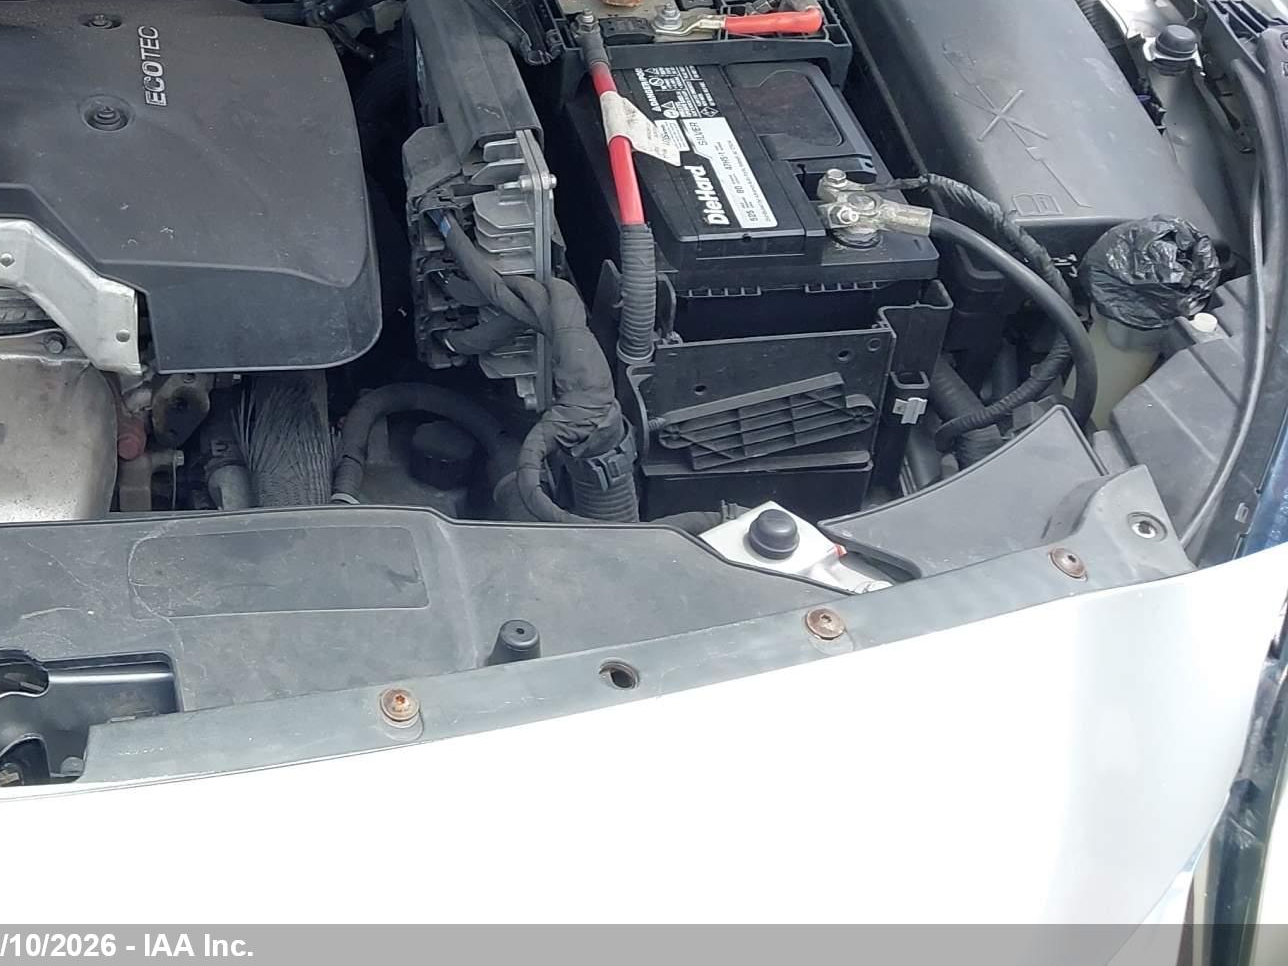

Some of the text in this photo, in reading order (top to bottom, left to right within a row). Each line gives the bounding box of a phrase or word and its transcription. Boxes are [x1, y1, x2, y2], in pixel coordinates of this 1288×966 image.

[138, 25, 167, 106] ECOTEC
[690, 122, 708, 146] SILVER
[684, 165, 730, 225] DieHard
